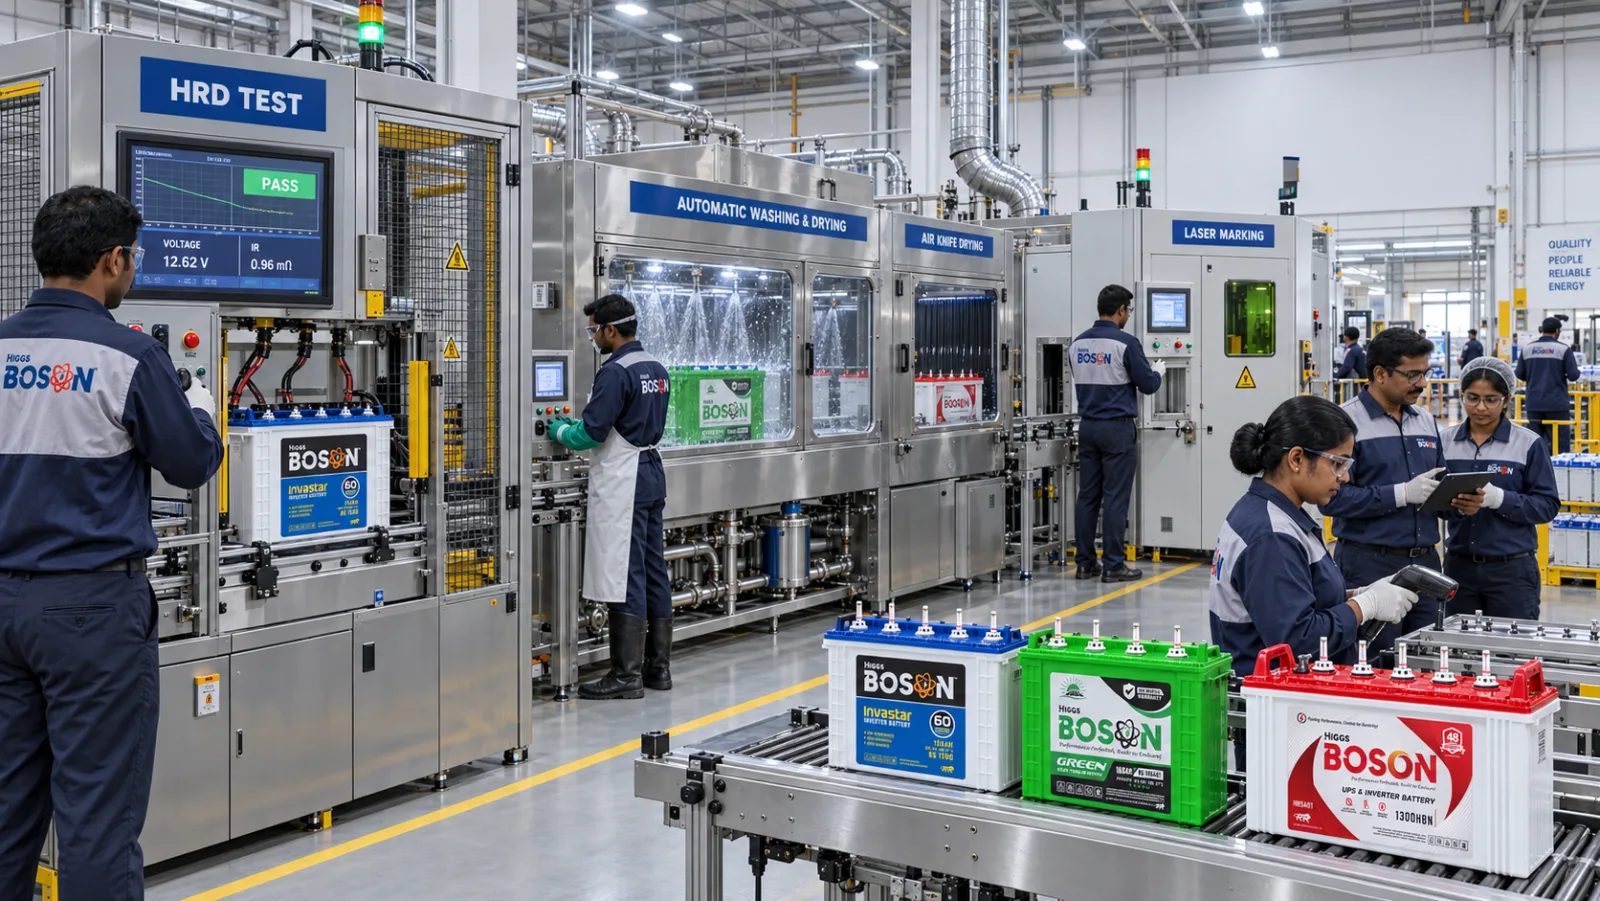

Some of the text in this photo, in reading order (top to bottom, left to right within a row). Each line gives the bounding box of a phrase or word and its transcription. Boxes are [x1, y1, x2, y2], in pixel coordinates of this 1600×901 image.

[171, 77, 302, 115] HRD TEST
[262, 177, 299, 192] PASS
[677, 196, 846, 232] AUTOMATIC WASHING & DRYING
[1184, 227, 1264, 241] LASER MARKING
[163, 239, 201, 249] VOLTAGE
[251, 243, 260, 252] IR
[921, 232, 984, 252] AIR KNIFE DRYING
[163, 255, 209, 269] 12.62 V
[251, 258, 274, 270] 0.96
[1548, 255, 1583, 265] PEOPLE
[1548, 268, 1591, 278] RELIABLE
[1548, 281, 1585, 291] ENERGY
[6, 353, 31, 362] HIGGS
[3, 363, 95, 393] BOSON
[288, 447, 359, 471] BOSON
[288, 482, 328, 495] Invastar
[344, 480, 356, 490] 60
[864, 661, 884, 670] HIGGS
[864, 670, 954, 700] BOSON
[863, 705, 912, 721] Invastar
[1058, 704, 1081, 714] HIGGS
[933, 715, 951, 727] 60
[1058, 715, 1162, 751] BOSON
[1324, 731, 1350, 742] HIGGS
[1446, 732, 1459, 743] 48
[1056, 757, 1107, 771] GREEN
[1323, 742, 1437, 783] BOSON
[1342, 786, 1356, 795] UPS
[1365, 790, 1400, 801] INVERTER
[1402, 794, 1436, 805] BATTERY
